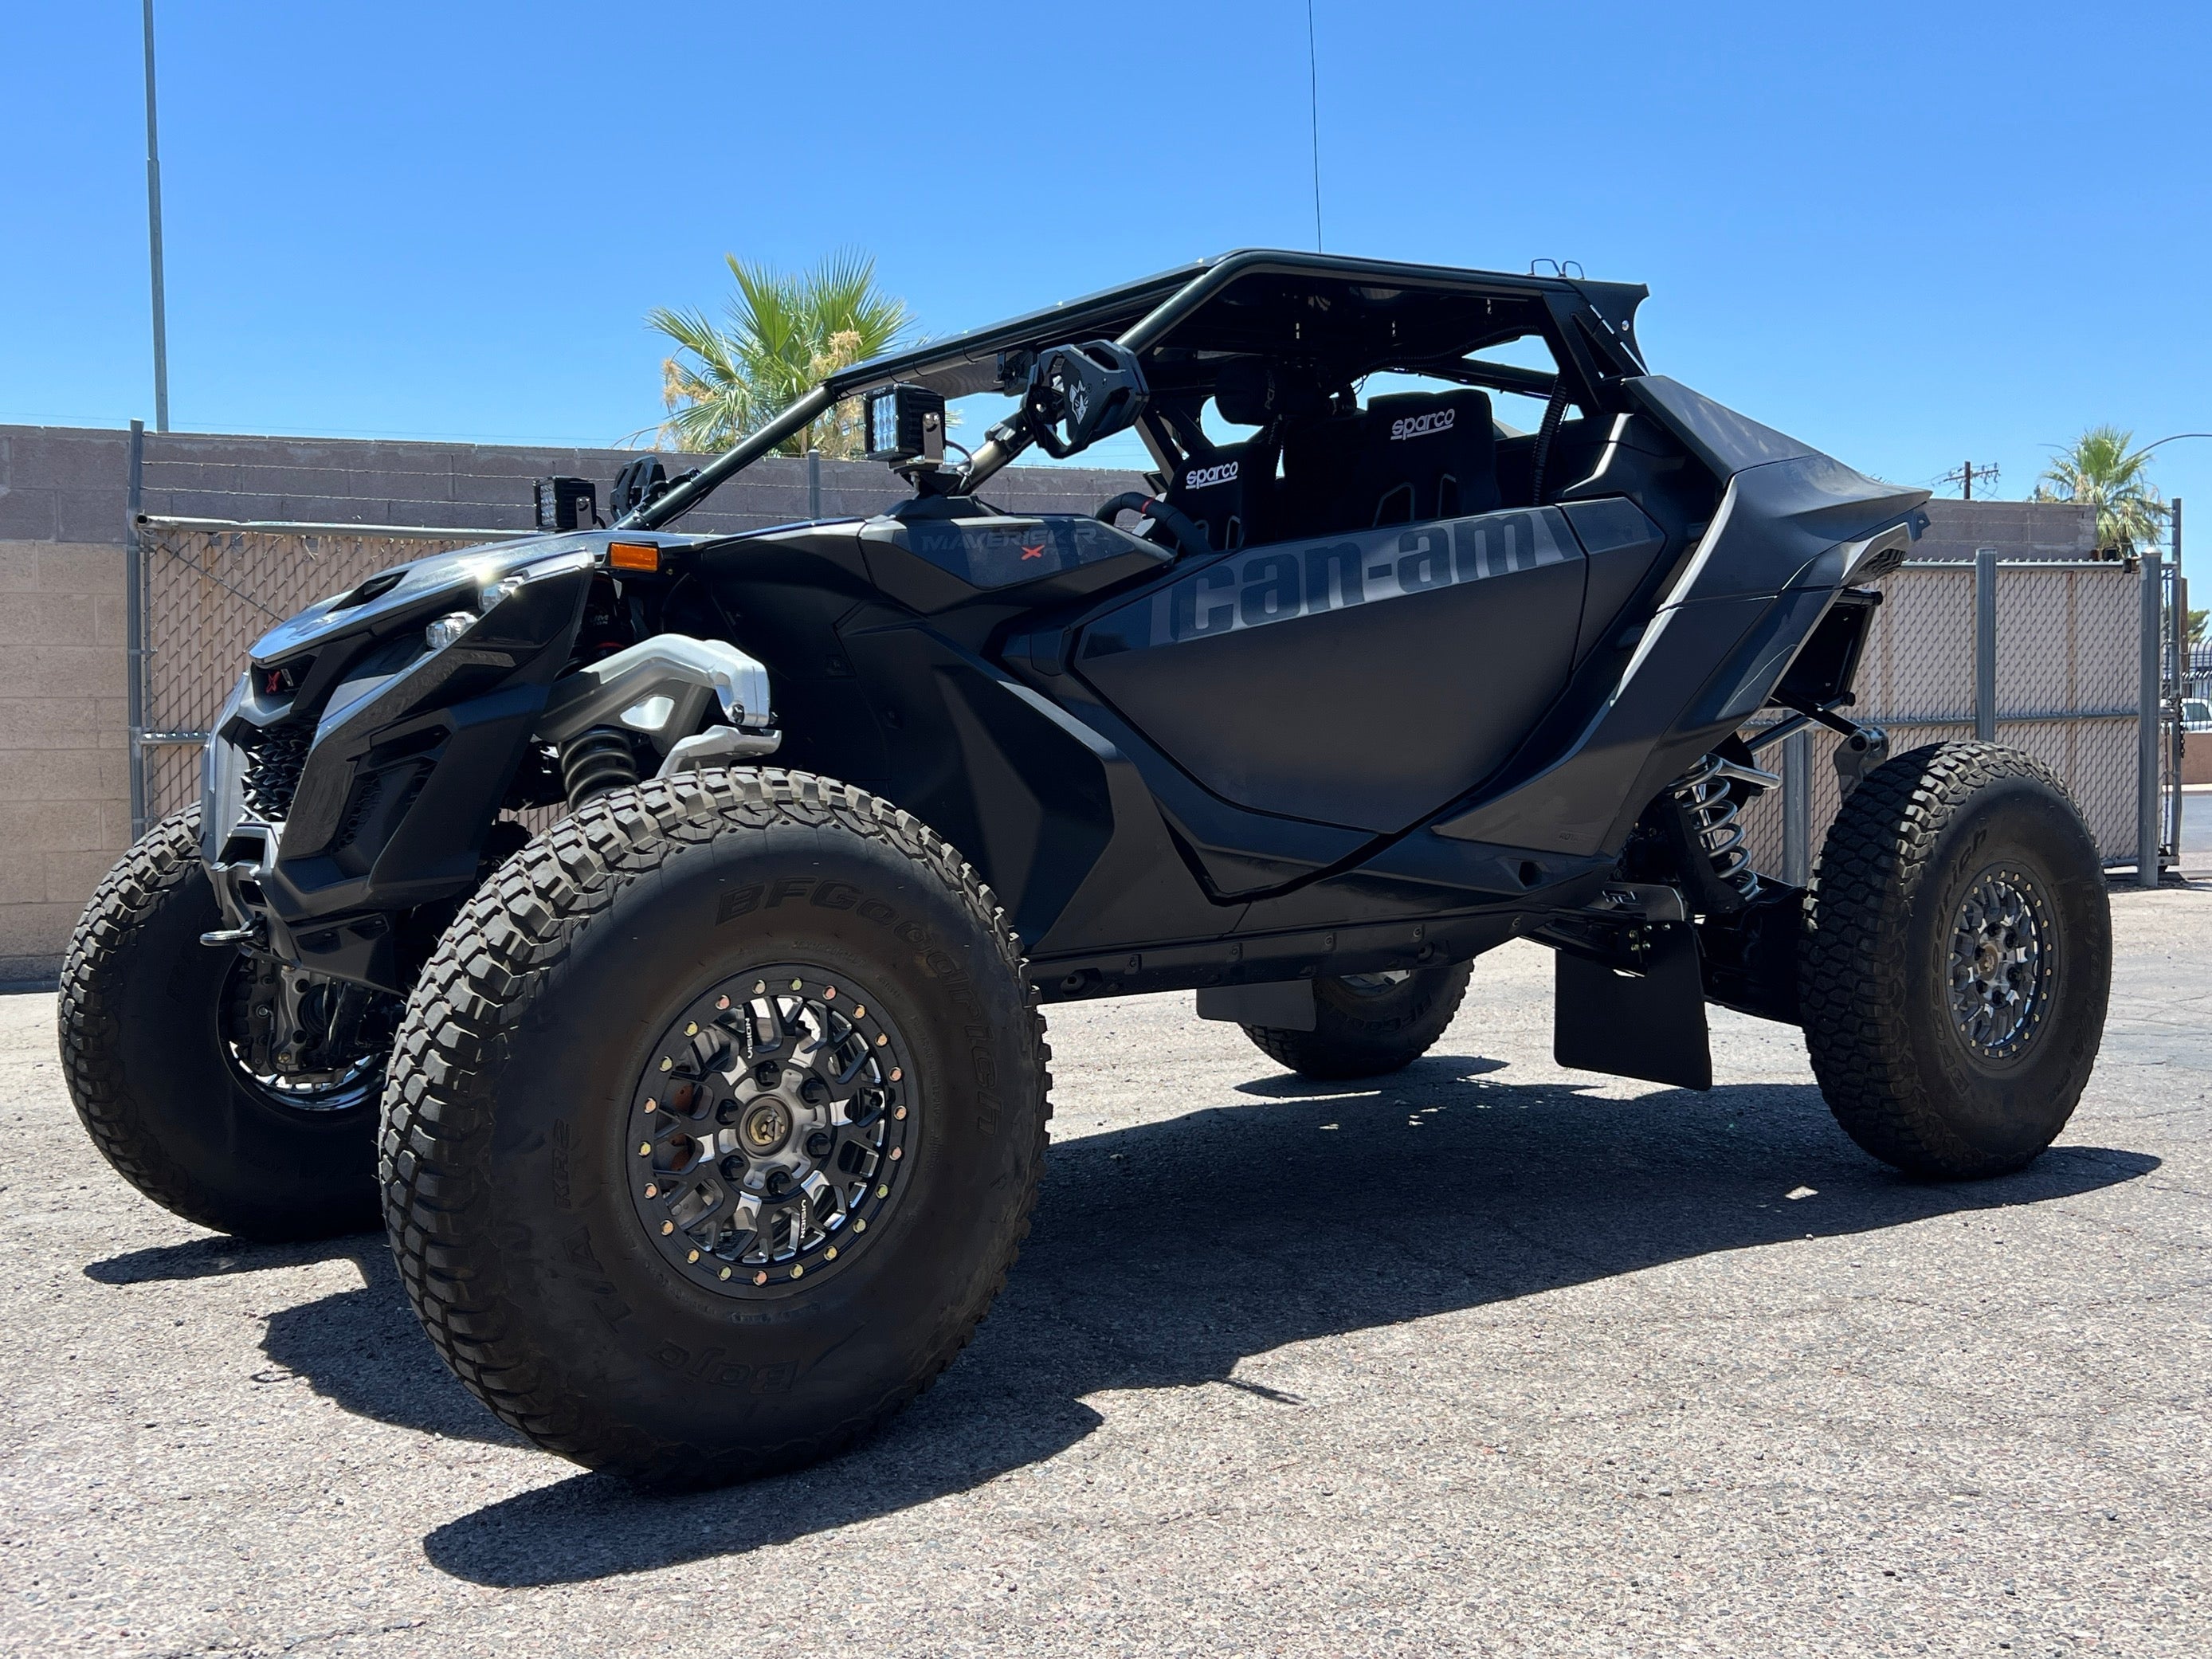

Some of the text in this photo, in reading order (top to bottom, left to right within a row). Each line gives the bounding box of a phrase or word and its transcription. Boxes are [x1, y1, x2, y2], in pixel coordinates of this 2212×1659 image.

[1390, 408, 1455, 441] sparco
[1186, 461, 1238, 489] sparco
[1169, 510, 1538, 643] can-am
[715, 877, 1004, 1137] BFGoodrich
[744, 1018, 753, 1059] VISION
[648, 1338, 799, 1394] Baja
